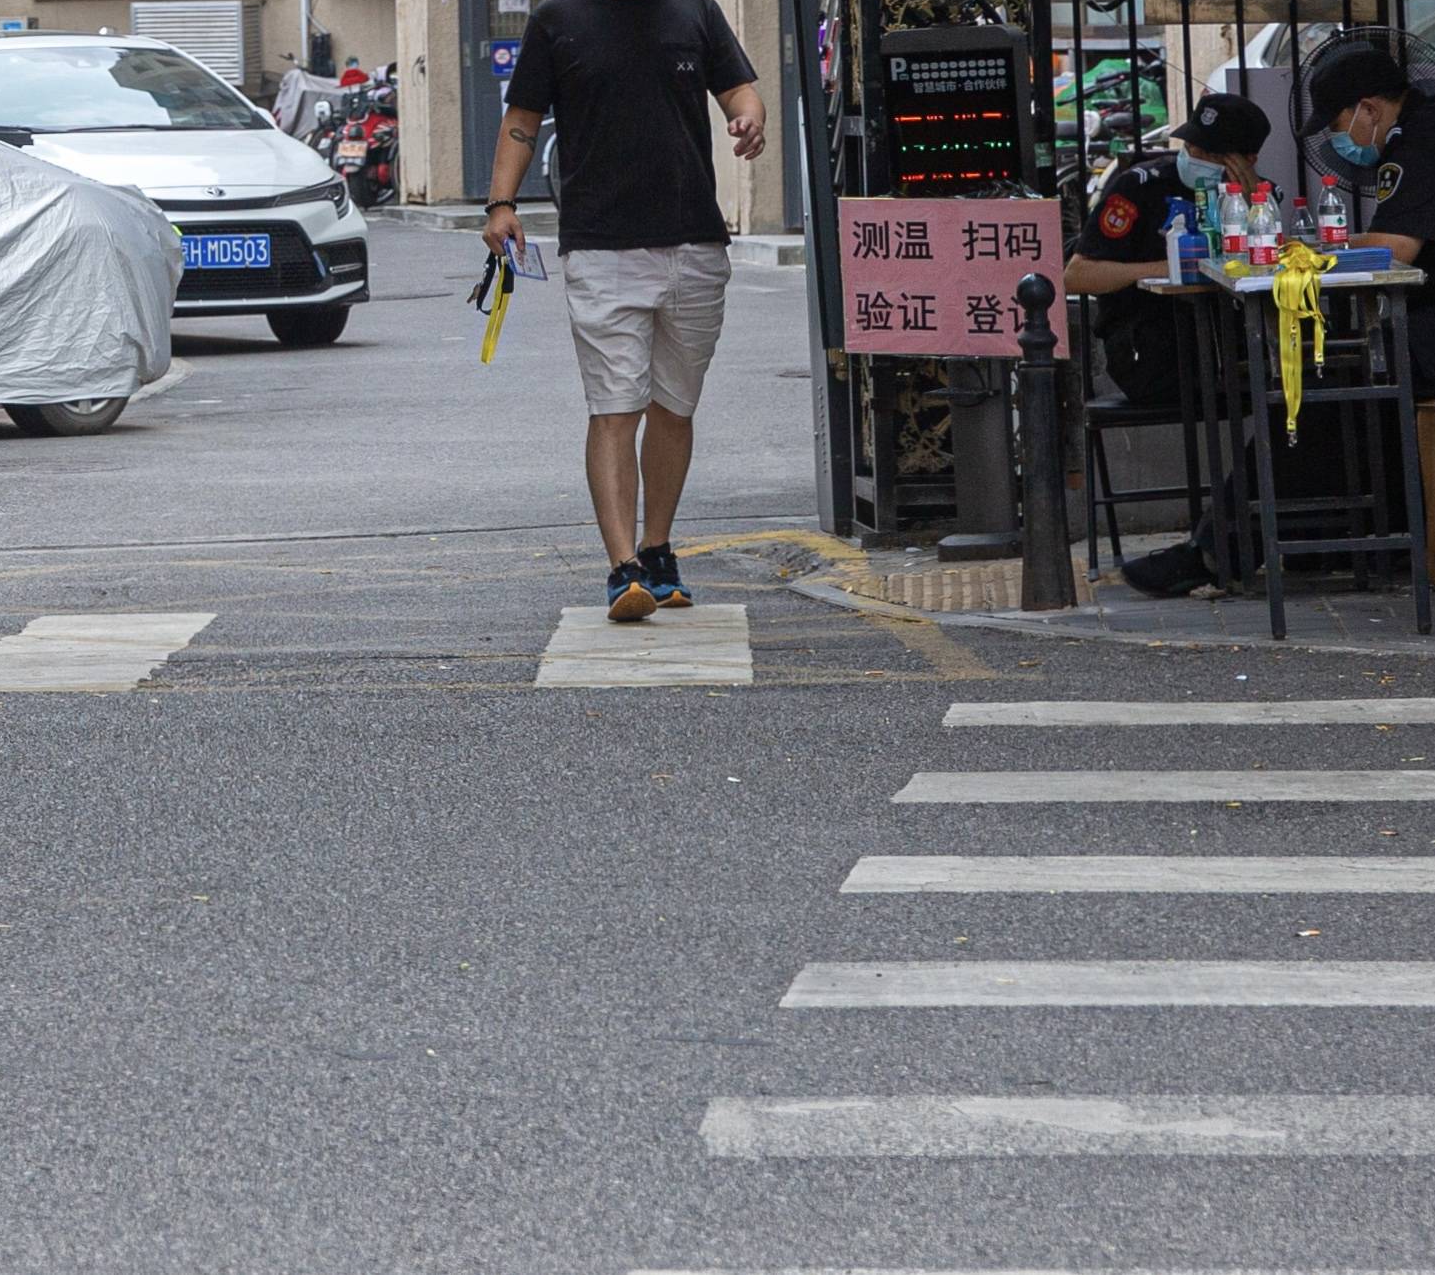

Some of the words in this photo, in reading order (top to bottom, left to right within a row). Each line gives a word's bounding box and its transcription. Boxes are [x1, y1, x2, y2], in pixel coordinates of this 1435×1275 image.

[852, 220, 934, 261] 测温
[962, 220, 1042, 261] 扫码
[856, 291, 938, 331] 验证
